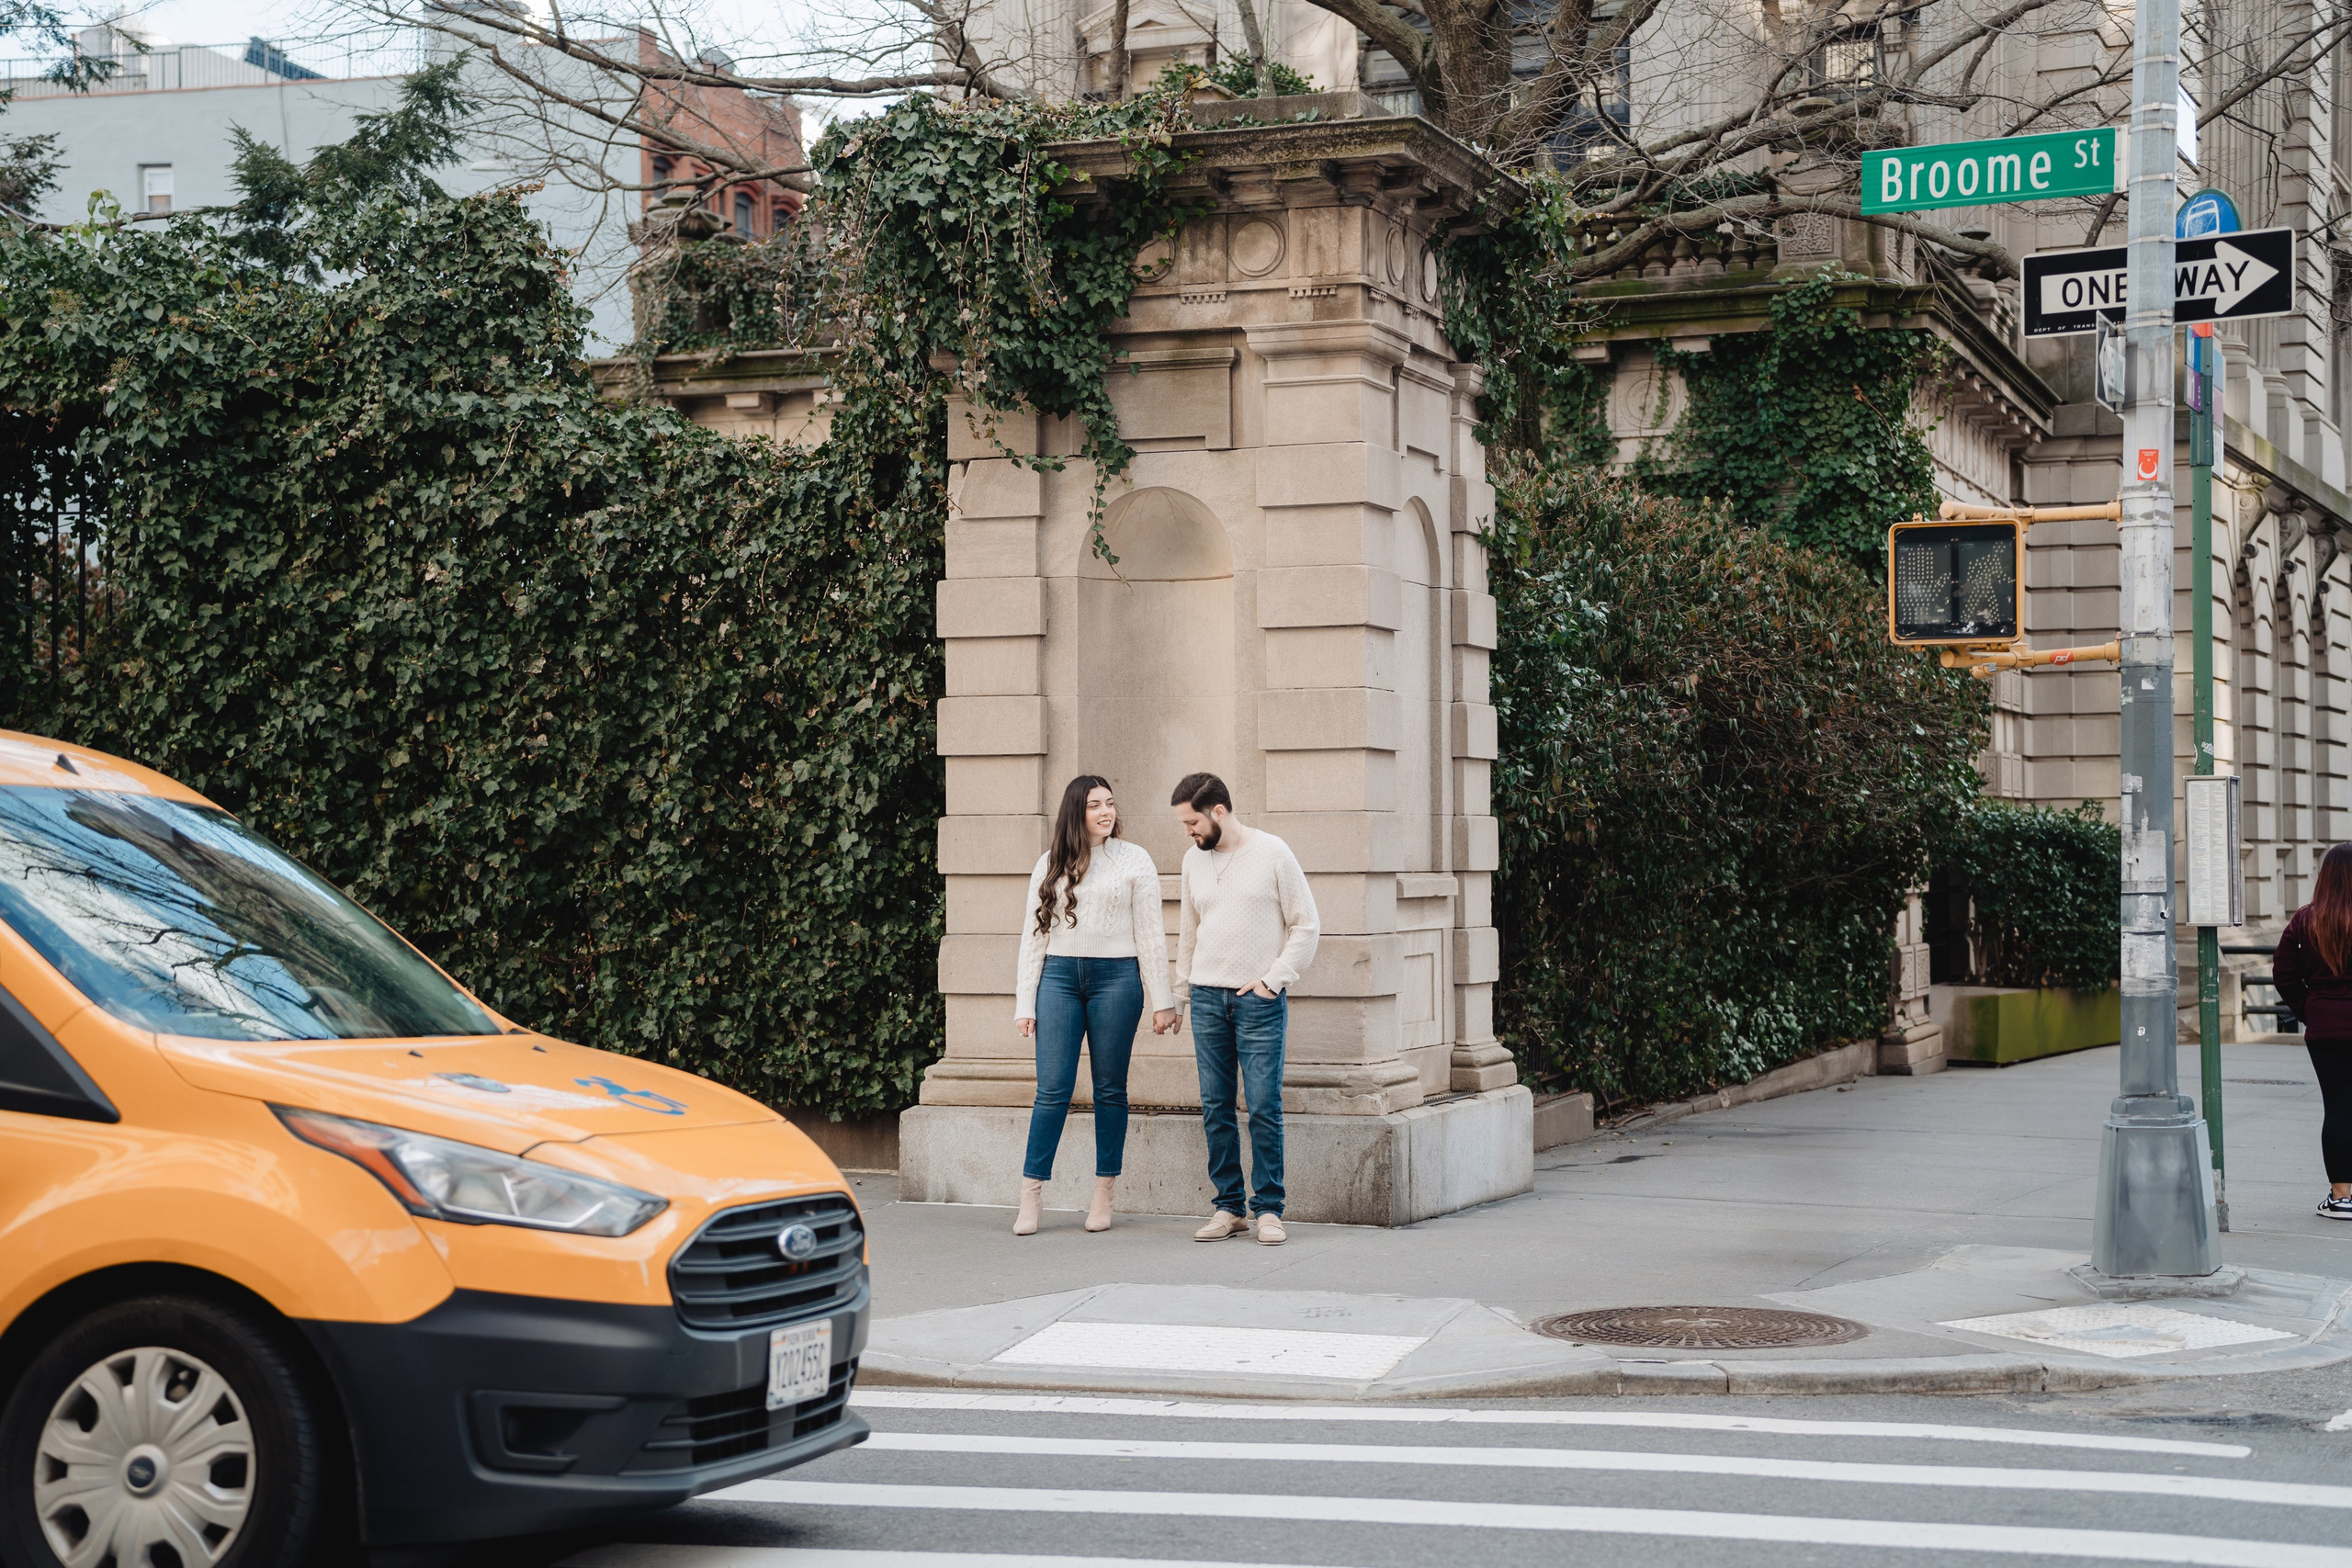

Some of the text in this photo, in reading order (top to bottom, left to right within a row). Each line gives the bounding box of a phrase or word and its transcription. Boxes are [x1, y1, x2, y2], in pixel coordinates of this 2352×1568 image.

[1882, 138, 2100, 203] Broome St
[2062, 260, 2251, 308] ONE WAY
